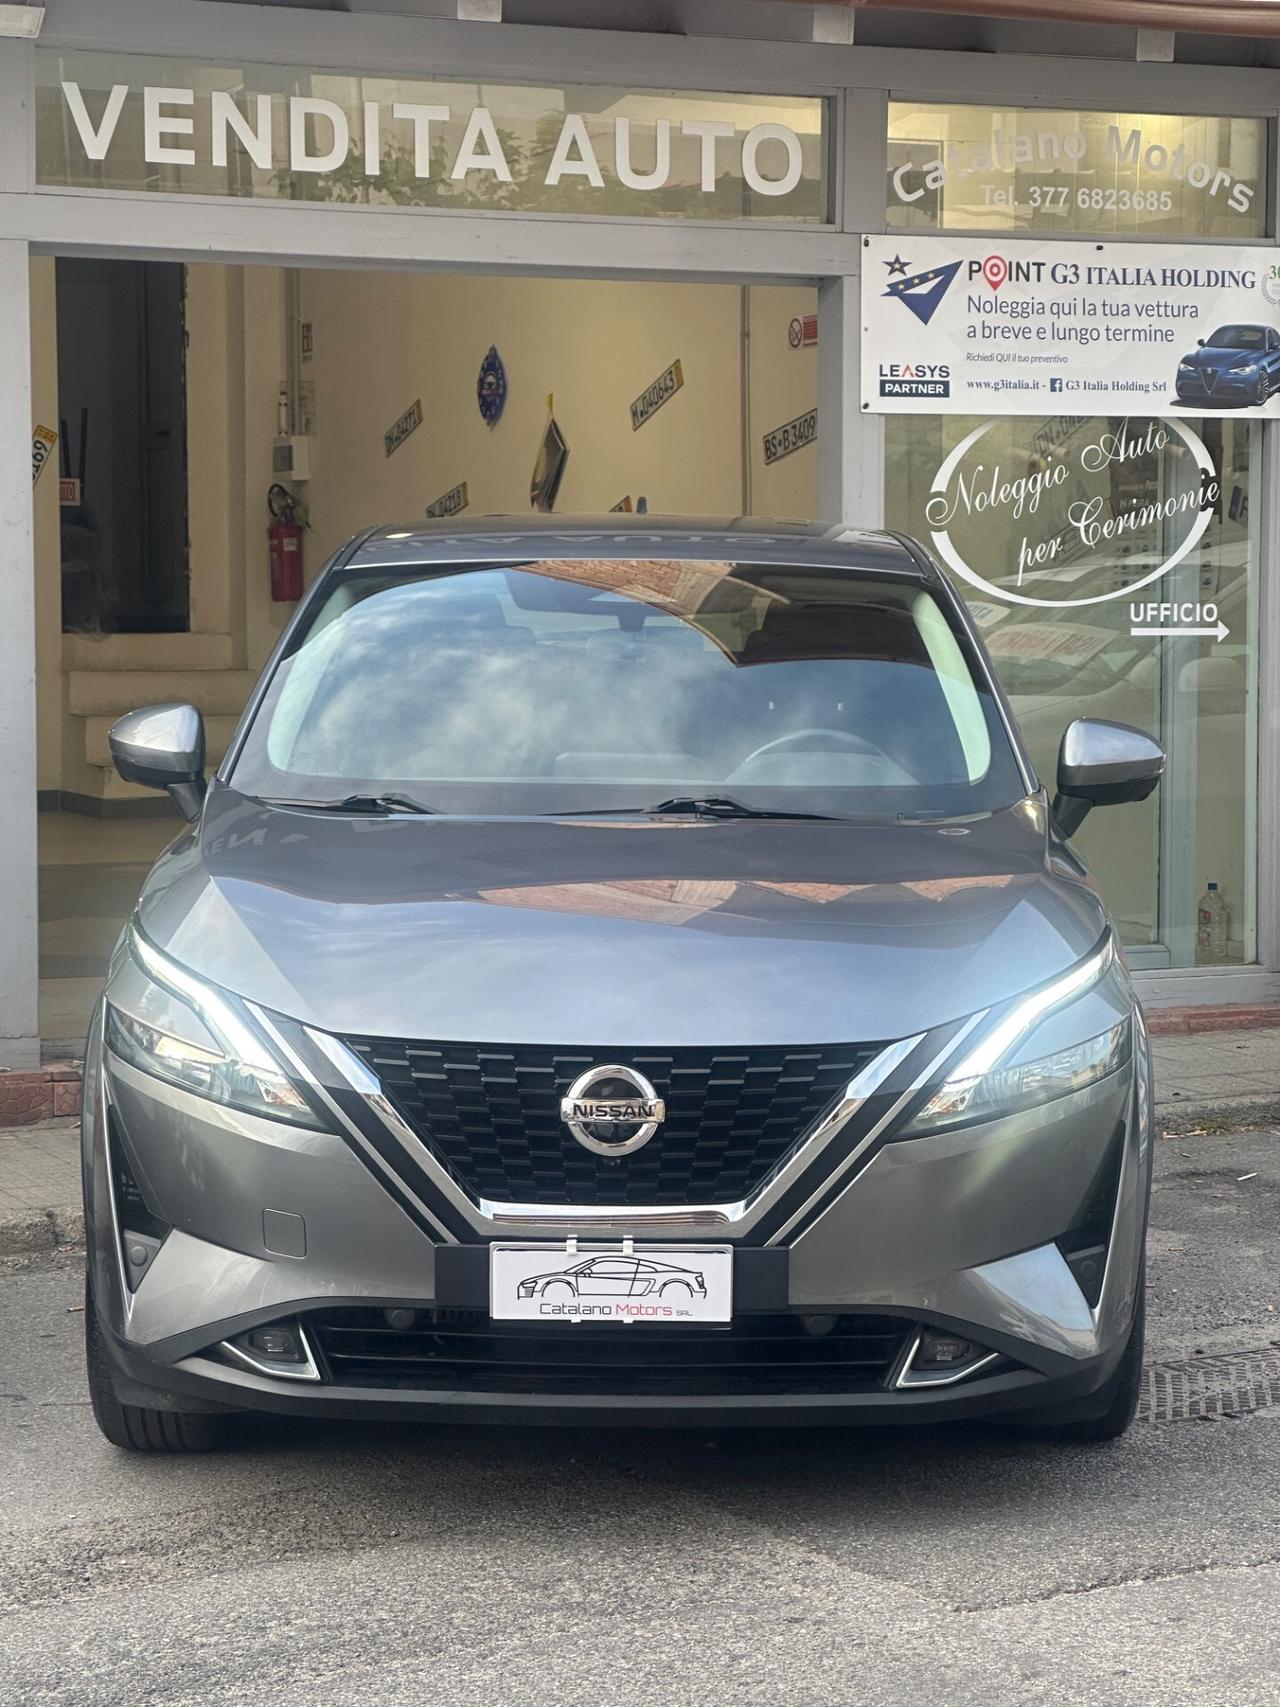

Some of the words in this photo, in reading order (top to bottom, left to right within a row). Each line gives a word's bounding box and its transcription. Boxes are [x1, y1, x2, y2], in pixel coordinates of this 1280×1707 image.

[61, 81, 512, 182] VENDITA
[544, 113, 803, 196] AUTO
[893, 128, 1087, 203] Catalano
[1104, 125, 1255, 213] Motors
[980, 185, 1018, 207] Tel.
[1028, 186, 1068, 208] 377
[1076, 188, 1172, 212] 6823685
[1050, 263, 1080, 285] G3
[1086, 266, 1159, 288] ITALIA
[1160, 267, 1257, 290] HOLDING
[967, 294, 1046, 319] Noleggia
[1050, 298, 1077, 320] qui
[1082, 298, 1097, 317] la
[1101, 301, 1131, 318] tua
[1134, 301, 1199, 319] vettura
[967, 325, 977, 339] a
[981, 319, 1032, 341] breve
[1036, 326, 1047, 341] e
[1051, 321, 1101, 345] lungo
[1105, 323, 1175, 343] termine
[966, 352, 995, 363] Richiedi
[996, 353, 1011, 363] QUI
[1018, 355, 1030, 363] tuo
[1031, 355, 1068, 364] preventivo
[879, 364, 950, 379] LEASYS
[885, 383, 944, 394] PARTNER
[966, 379, 1040, 391] www.g3italia.it
[1066, 381, 1080, 391] G3
[1083, 382, 1109, 391] Italia
[1111, 382, 1151, 393] Holding
[1152, 381, 1167, 391] Srl
[926, 455, 1070, 526] Noleggio
[1081, 416, 1171, 472] Auto
[1017, 537, 1063, 587] per
[1068, 474, 1220, 549] Cerimonie
[1130, 602, 1218, 623] UFFICIO
[573, 1104, 655, 1118] NISSAN
[539, 1303, 612, 1315] Catalano
[615, 1303, 672, 1316] Motors
